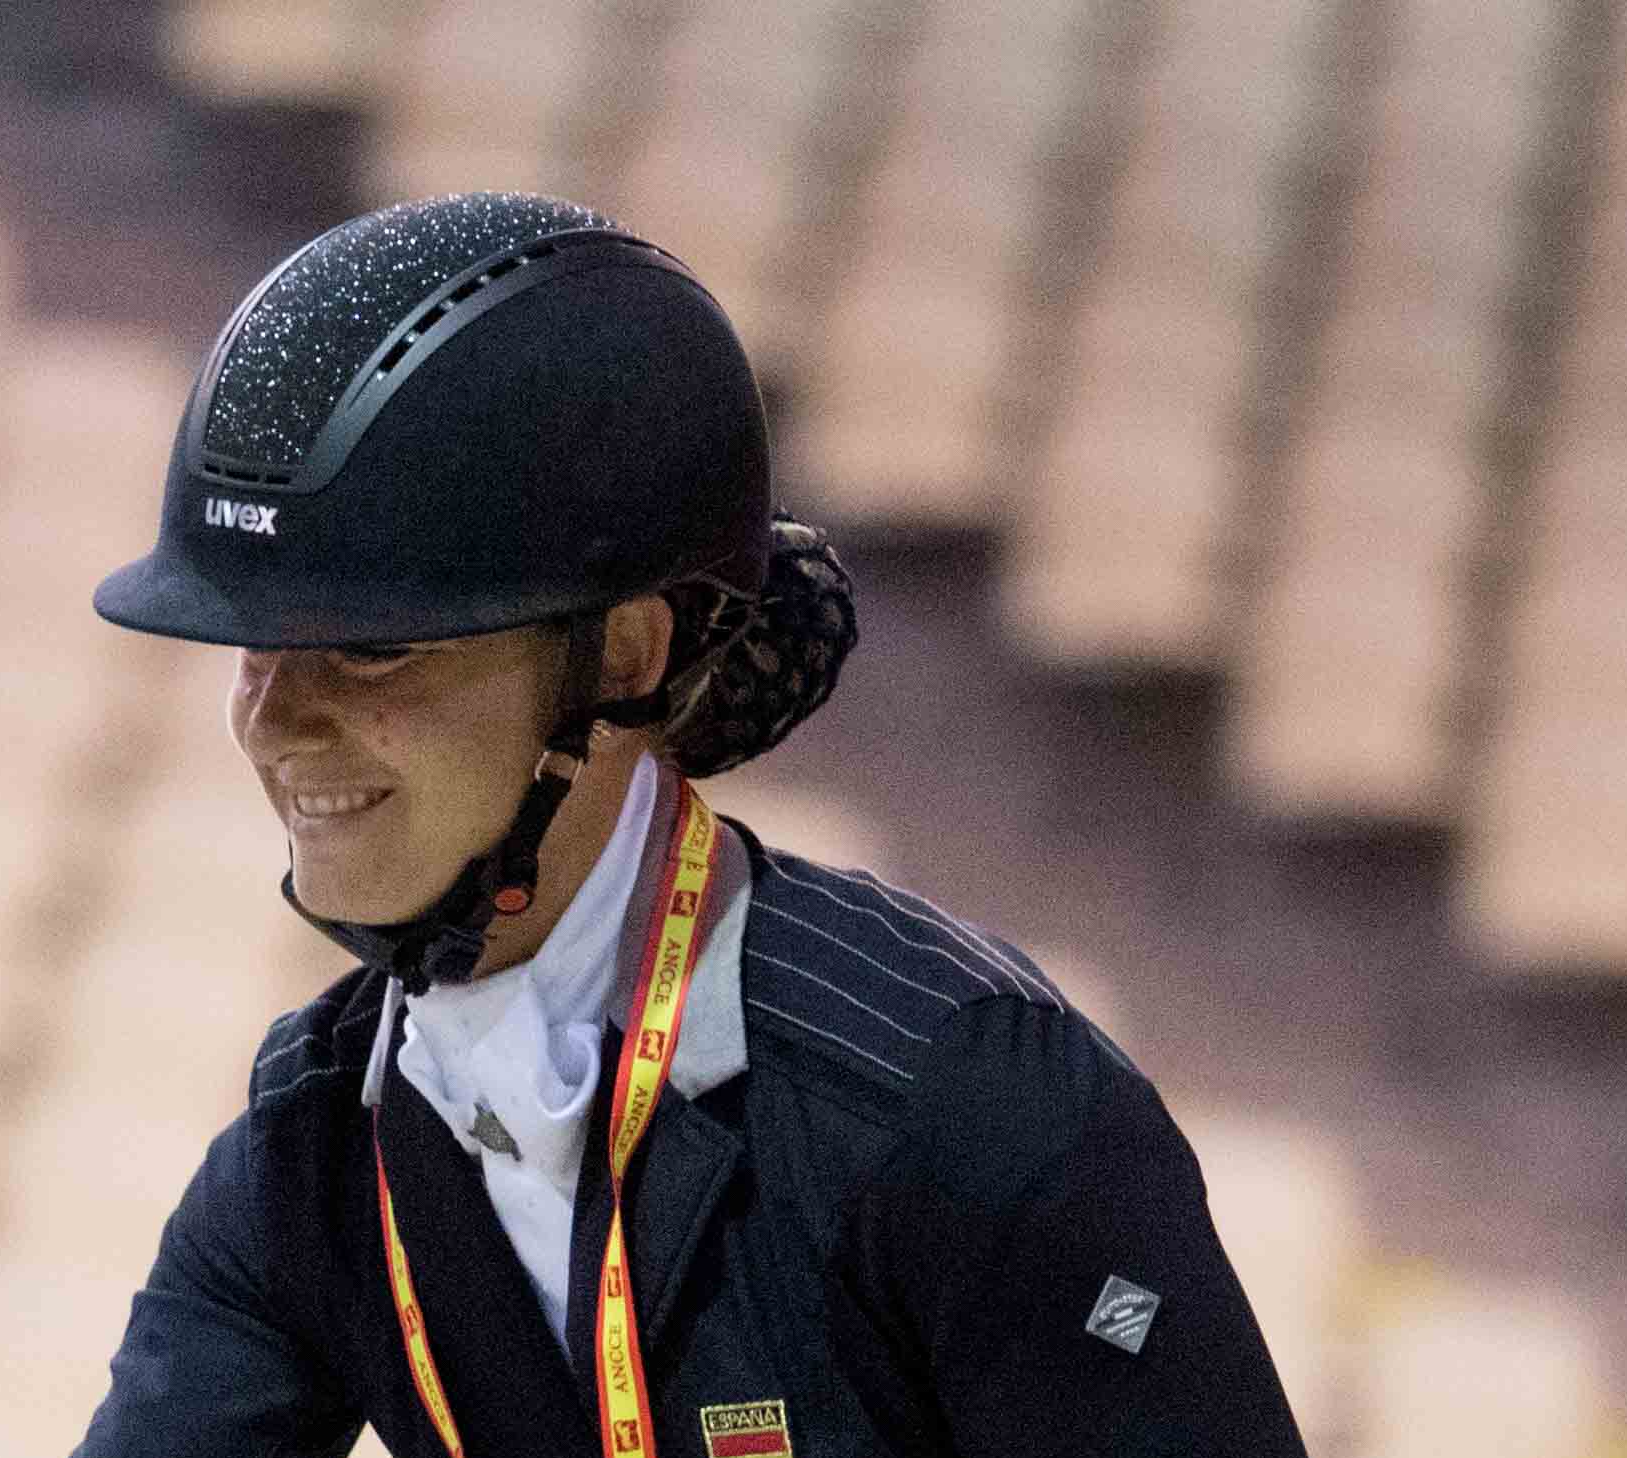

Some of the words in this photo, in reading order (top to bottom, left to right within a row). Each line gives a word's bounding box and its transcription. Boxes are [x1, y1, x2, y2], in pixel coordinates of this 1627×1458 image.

[205, 497, 278, 536] uvex
[653, 936, 682, 1007] ANCCE
[608, 1322, 630, 1393] ANCCE
